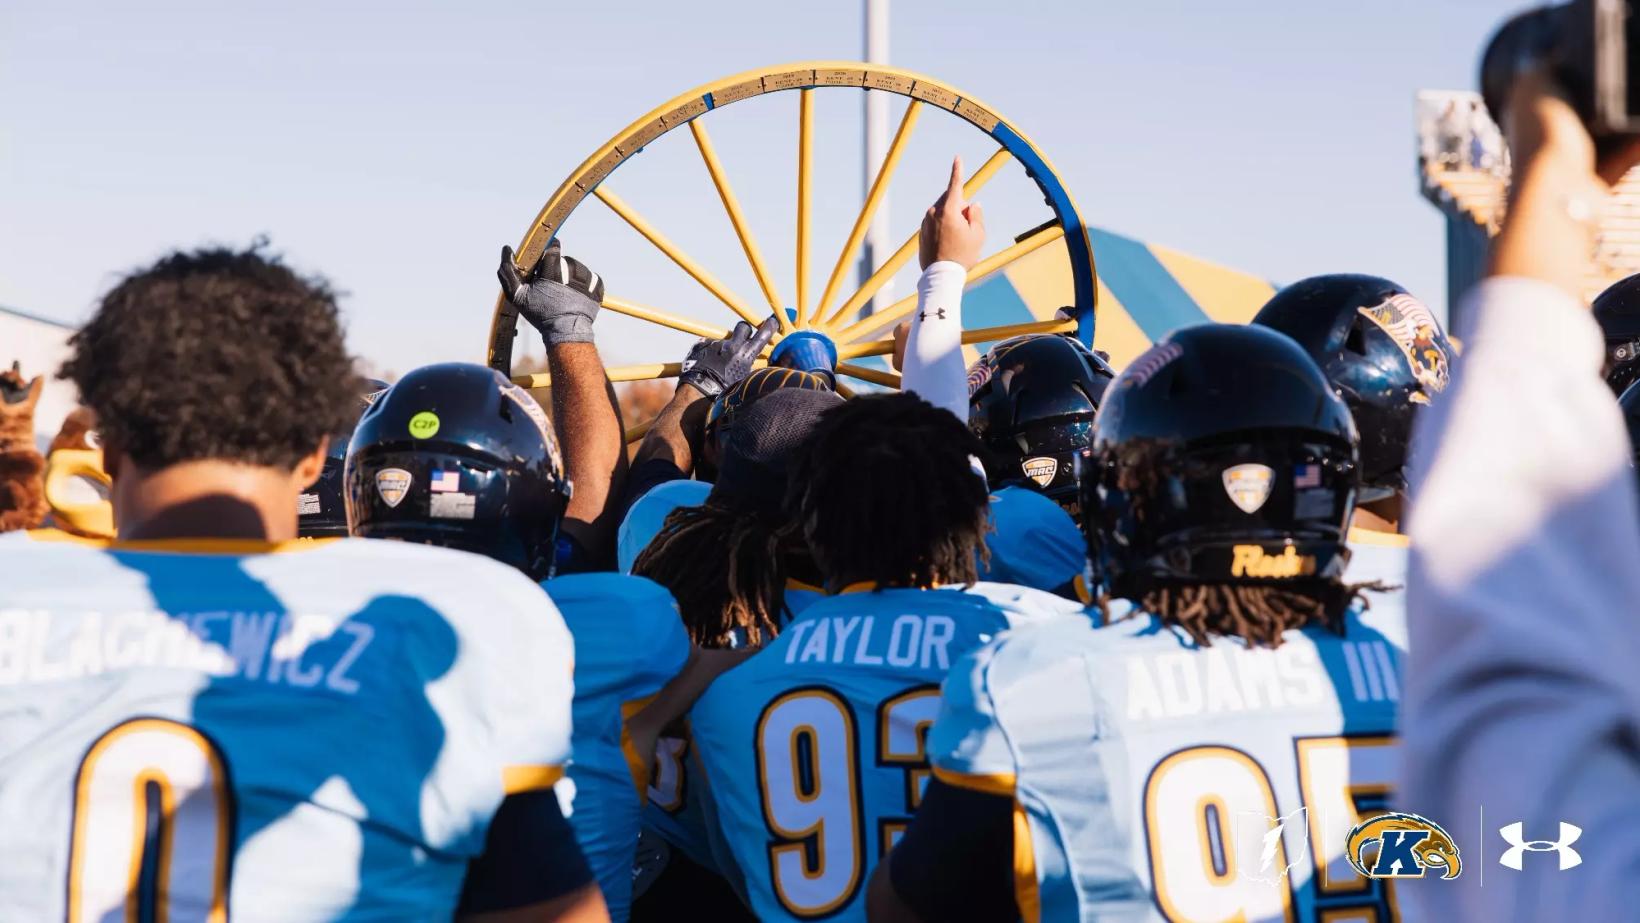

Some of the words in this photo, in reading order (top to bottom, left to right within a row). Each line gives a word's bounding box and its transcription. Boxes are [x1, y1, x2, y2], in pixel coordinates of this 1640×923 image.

[412, 420, 436, 429] C2P
[1027, 465, 1055, 477] MAC
[784, 614, 956, 670] TAYLOR
[1126, 643, 1325, 720] ADAMS
